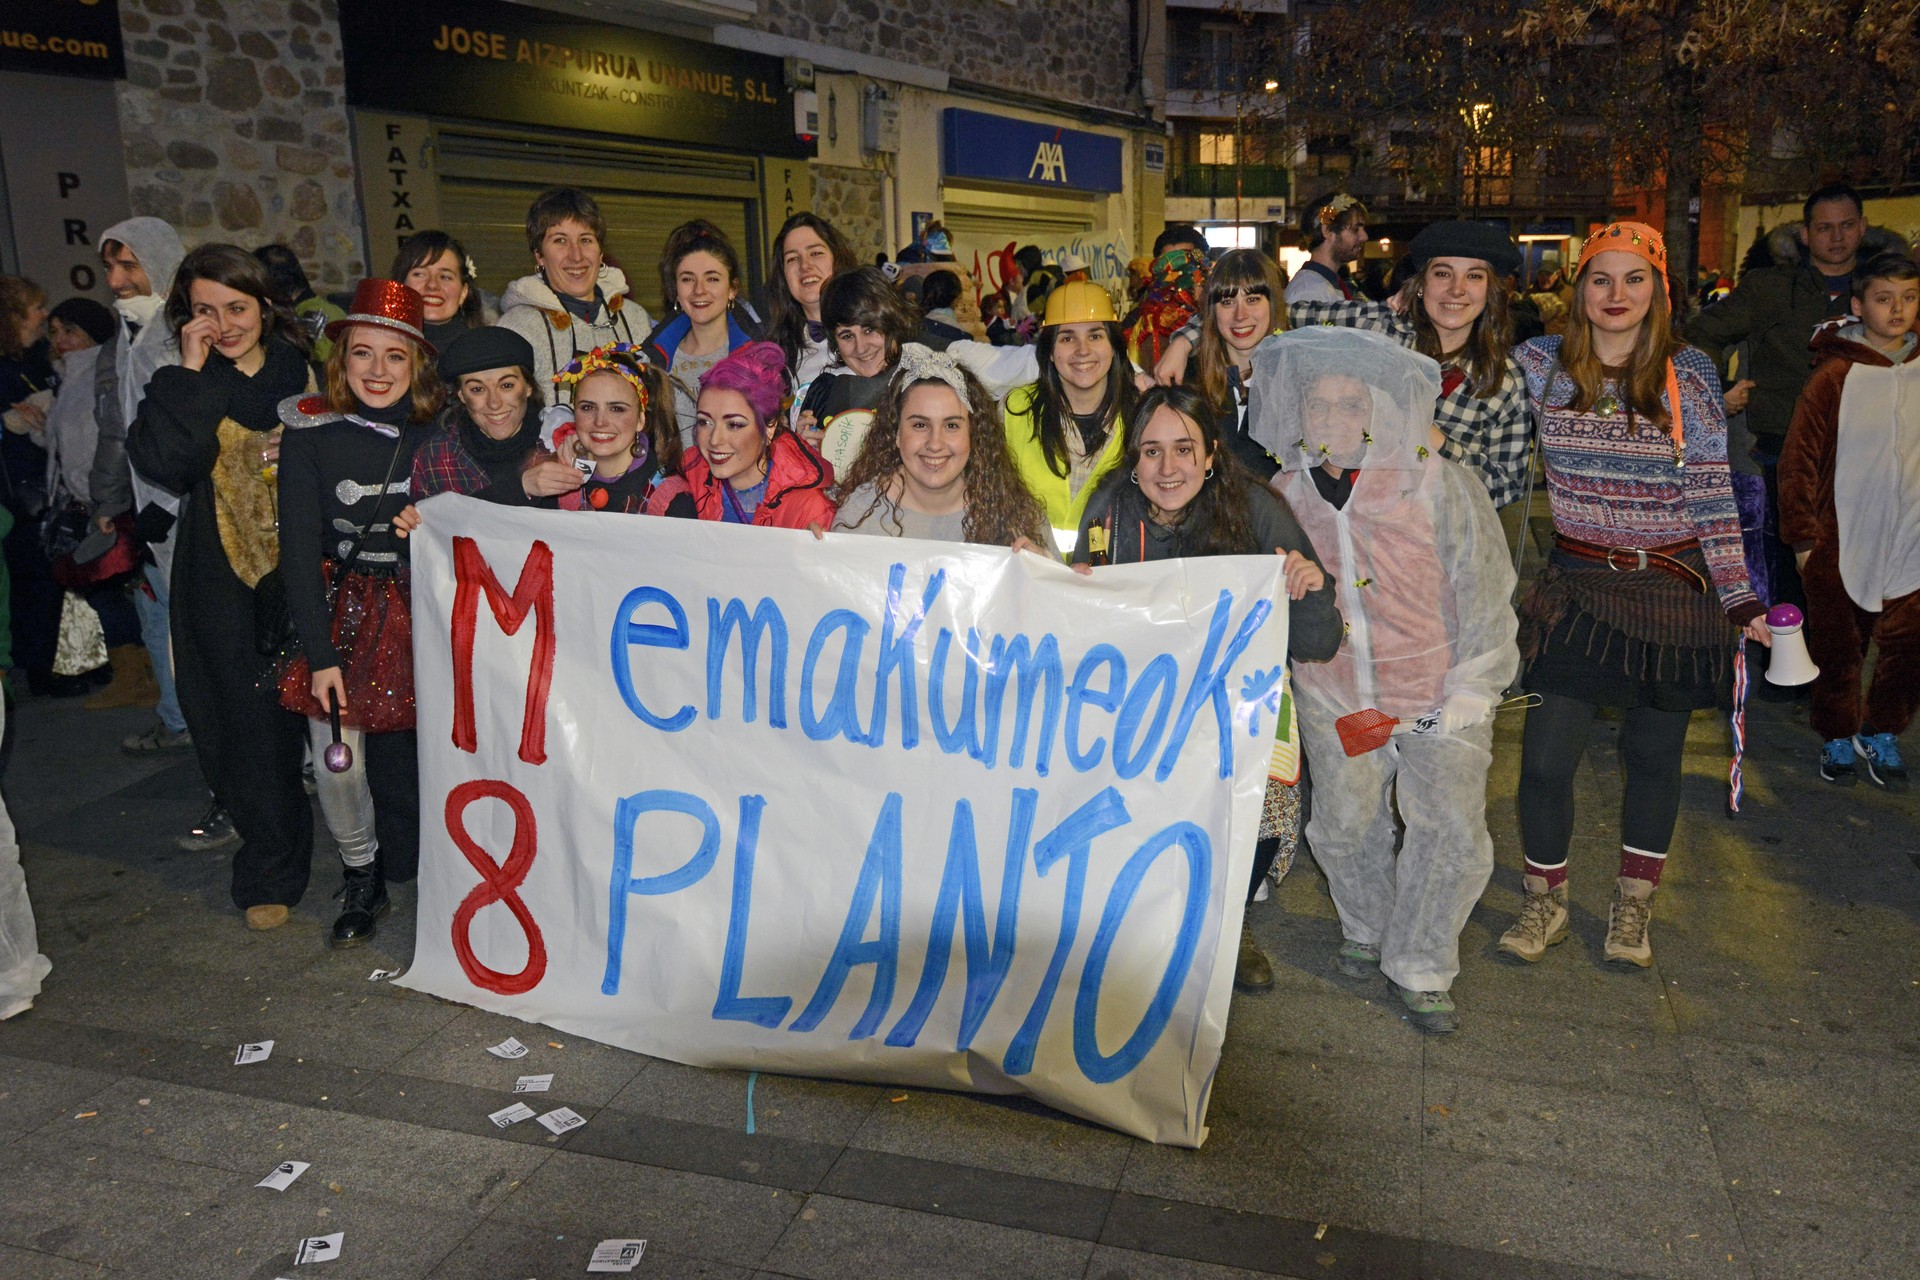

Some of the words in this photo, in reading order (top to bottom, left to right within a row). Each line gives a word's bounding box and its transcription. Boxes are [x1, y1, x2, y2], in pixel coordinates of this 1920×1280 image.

[433, 24, 507, 61] JOSE
[515, 37, 642, 83] AIZPURUA
[744, 78, 778, 105] S.L.
[1028, 141, 1067, 183] AXA
[445, 779, 548, 997] 8
[602, 786, 1212, 1085] PLANTO
